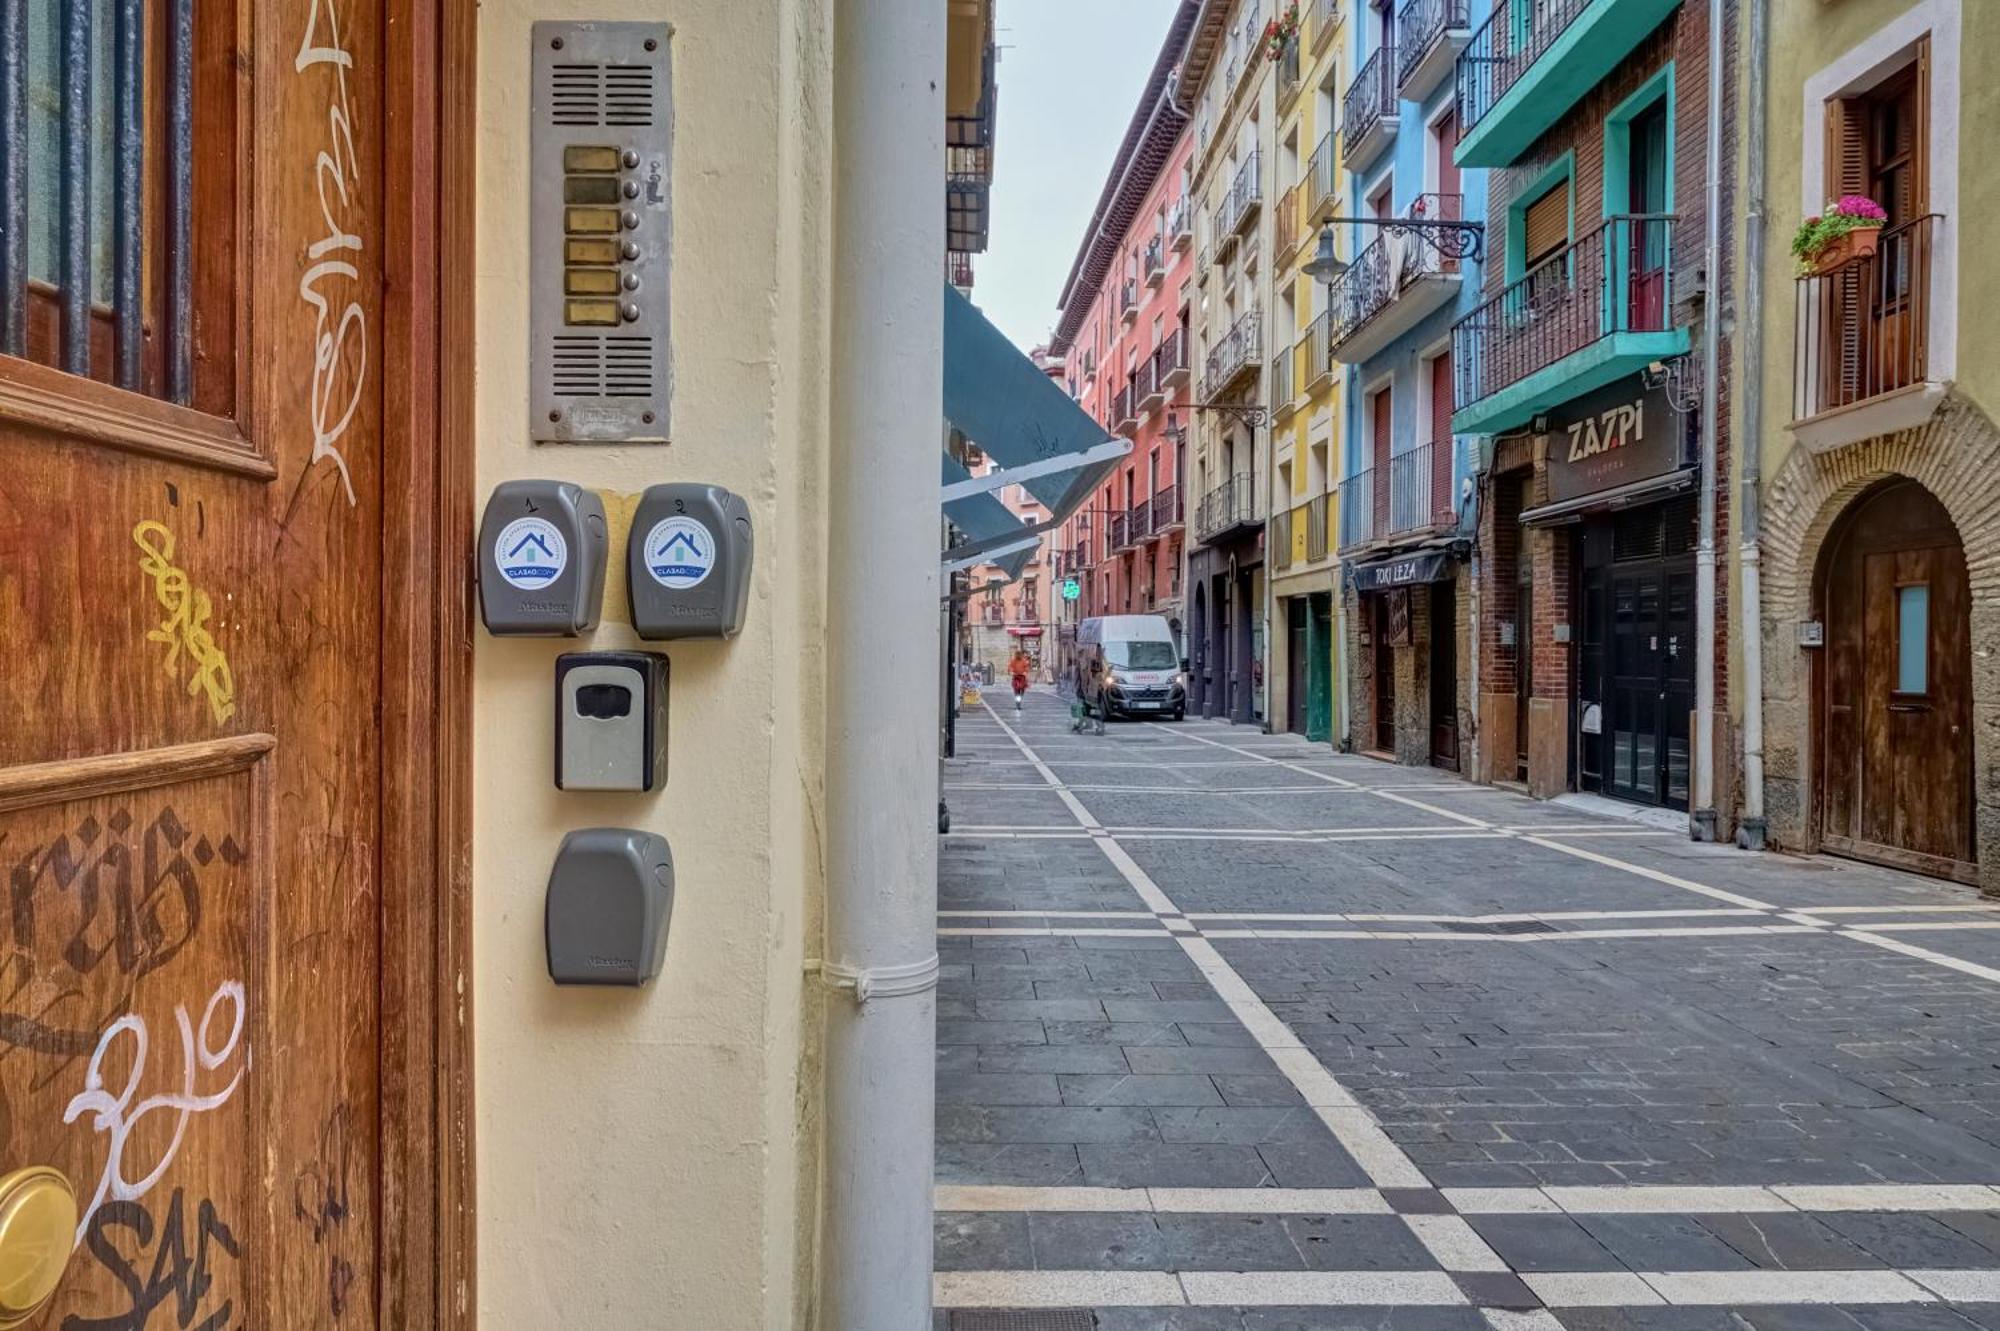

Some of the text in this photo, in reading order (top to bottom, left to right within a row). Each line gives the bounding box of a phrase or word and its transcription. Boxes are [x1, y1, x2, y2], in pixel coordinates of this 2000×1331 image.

[525, 496, 539, 513] 1
[674, 498, 687, 514] 2
[1393, 561, 1417, 582] LEZA
